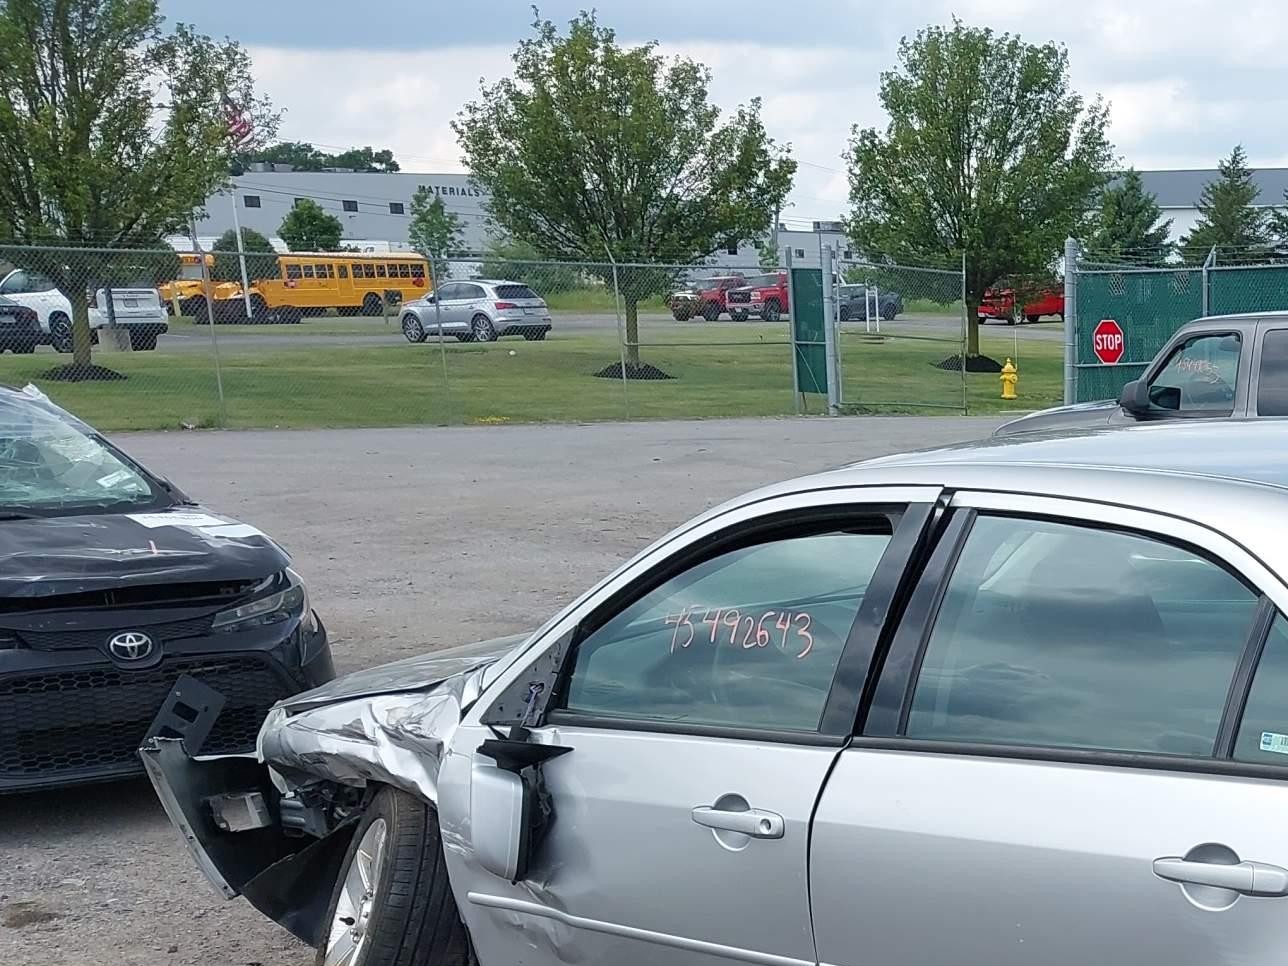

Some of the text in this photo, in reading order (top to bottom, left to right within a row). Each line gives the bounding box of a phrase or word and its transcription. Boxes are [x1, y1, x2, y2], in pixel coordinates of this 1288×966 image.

[418, 185, 480, 197] MATERIALS
[1096, 334, 1121, 350] STOP
[665, 604, 813, 658] 45492643
